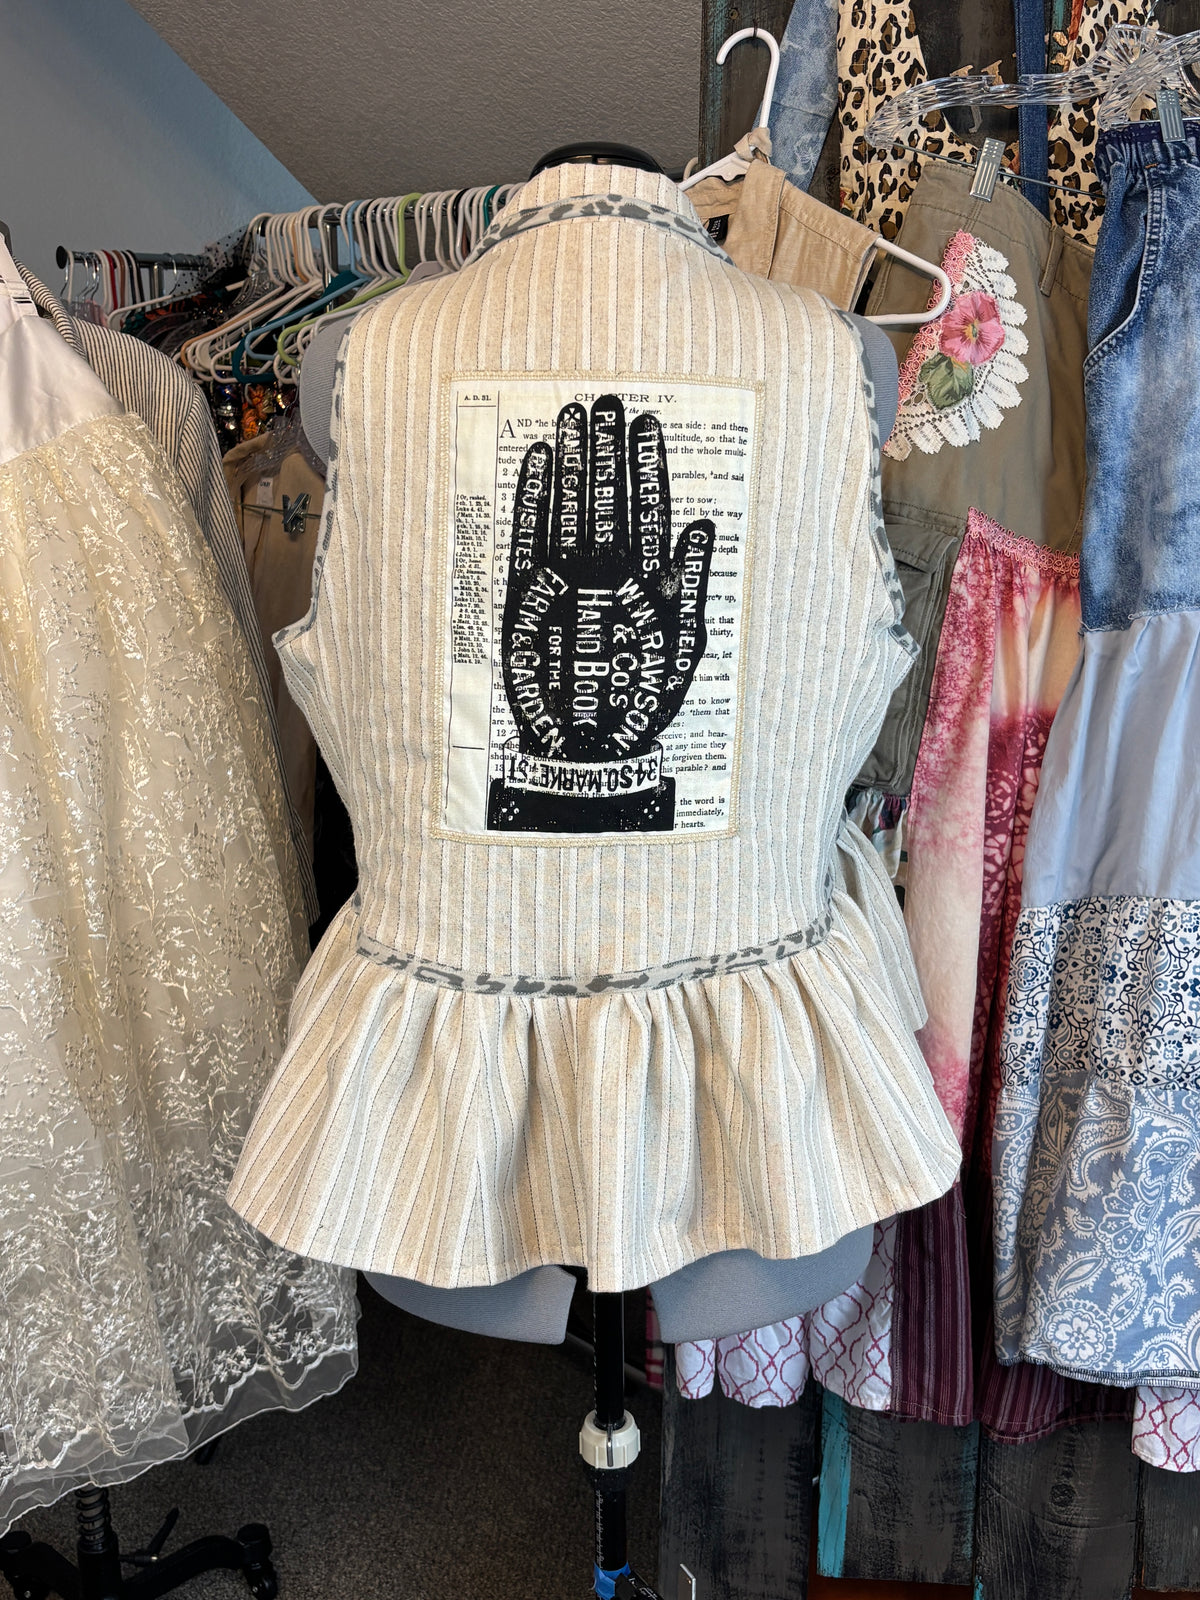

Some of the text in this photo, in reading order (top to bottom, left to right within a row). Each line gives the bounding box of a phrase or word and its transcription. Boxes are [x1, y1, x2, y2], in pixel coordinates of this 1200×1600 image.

[657, 394, 677, 403] IV.
[670, 422, 683, 430] sea
[711, 422, 727, 431] and
[729, 423, 749, 433] there
[719, 435, 736, 444] that
[738, 437, 748, 446] he
[498, 444, 529, 453] entered
[680, 446, 694, 455] the
[697, 446, 722, 456] whole
[498, 456, 517, 465] tude
[502, 469, 508, 477] 2
[671, 470, 708, 481] parables,
[731, 472, 745, 482] said
[497, 482, 516, 490] unto
[501, 493, 507, 501] 3
[686, 496, 695, 504] to
[500, 505, 506, 513] 4
[683, 507, 743, 520] fell by the way
[500, 529, 506, 538] 5
[719, 533, 740, 542] much
[495, 542, 511, 550] eart
[718, 545, 738, 556] depth
[494, 552, 503, 562] of
[498, 565, 504, 574] 6
[709, 569, 738, 578] because
[493, 577, 500, 586] it
[498, 589, 503, 598] 7
[719, 616, 734, 624] that
[709, 628, 734, 638] thirty,
[548, 626, 562, 691] FOR THE
[572, 588, 613, 729] HAND BOOK
[722, 651, 733, 659] let
[699, 672, 730, 682] him with
[710, 697, 731, 705] know
[492, 705, 506, 714] the
[715, 707, 730, 716] that
[496, 729, 507, 737] 12
[689, 730, 704, 738] and
[707, 729, 728, 738] hear-
[665, 740, 727, 752] at any time they
[671, 754, 703, 764] forgiven
[705, 752, 727, 761] them.
[675, 763, 709, 774] parable?
[711, 763, 727, 771] and
[679, 795, 726, 806] the word is
[676, 807, 725, 818] immediately,
[681, 820, 706, 829] hearts.
